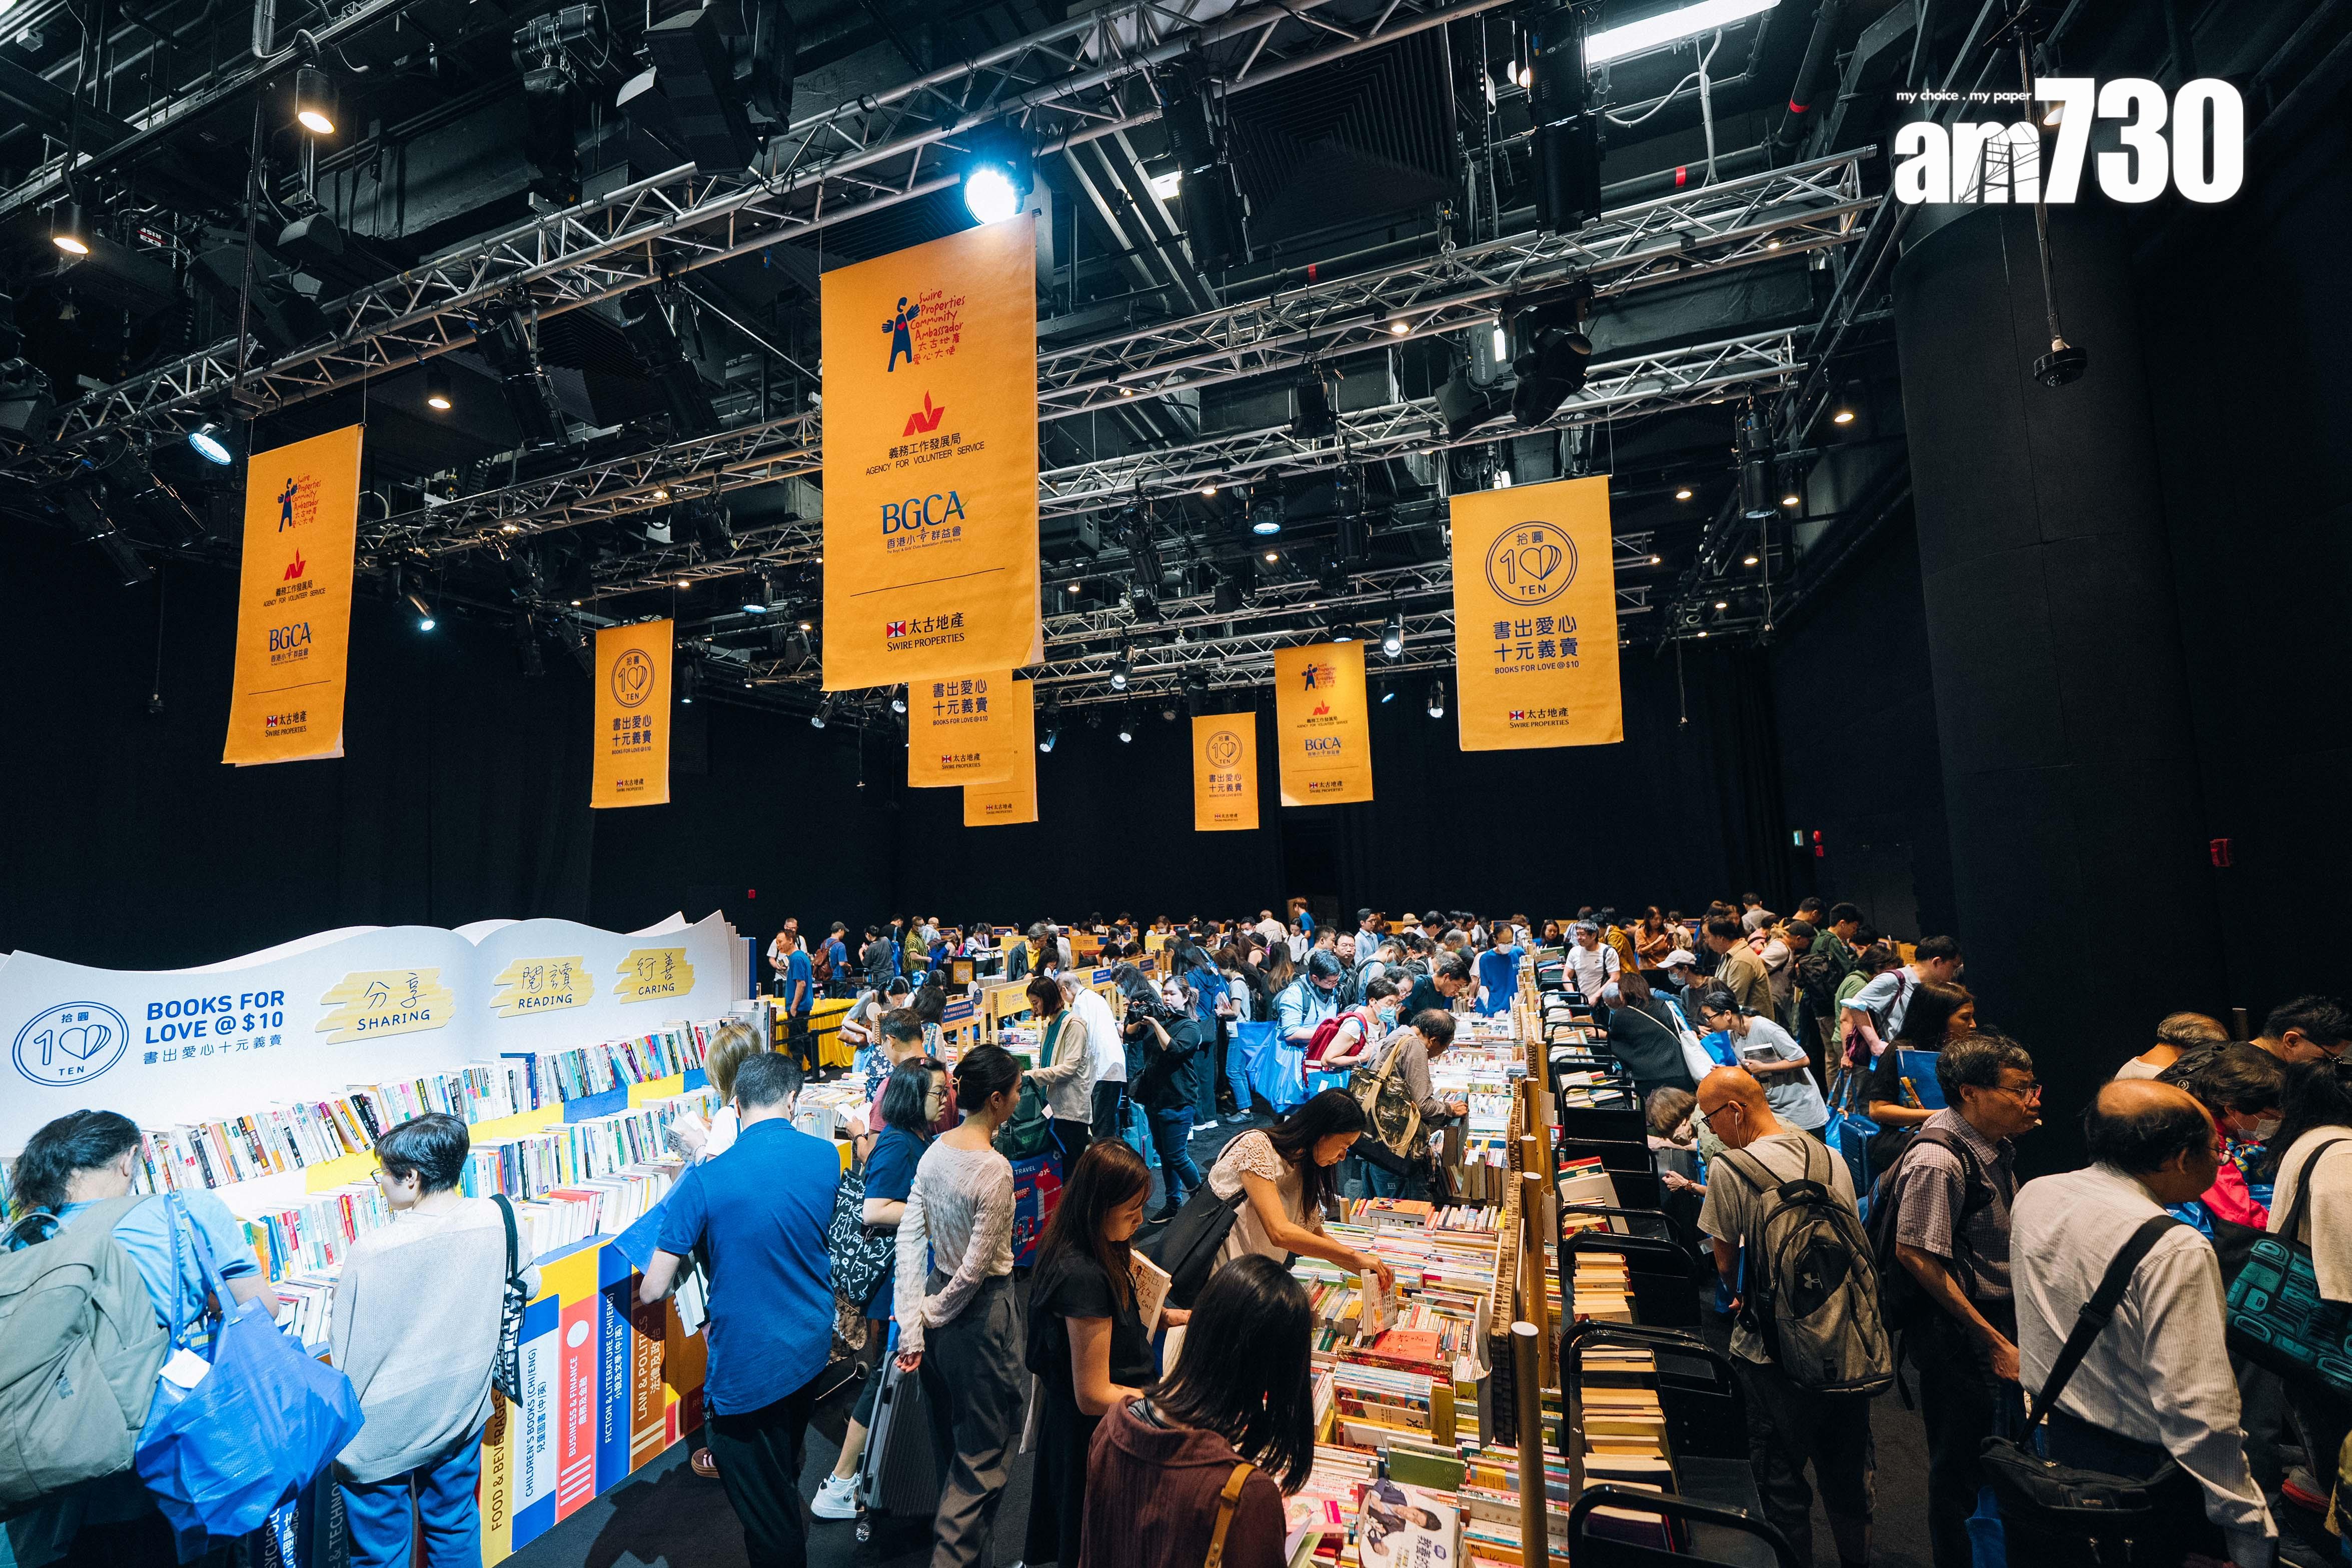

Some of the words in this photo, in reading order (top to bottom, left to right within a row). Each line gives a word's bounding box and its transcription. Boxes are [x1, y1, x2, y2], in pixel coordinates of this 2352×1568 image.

[919, 289, 942, 304] Swire
[921, 296, 965, 315] Properties
[911, 310, 957, 330] Community
[915, 322, 963, 341] Ambassador
[918, 333, 959, 351] 太古地產
[913, 346, 955, 365] 愛心大使
[889, 433, 960, 460] 義務工作發展局
[866, 463, 890, 476] AGENCY
[896, 459, 909, 469] FOR
[914, 449, 952, 465] VOLUNTEER
[957, 441, 984, 456] SERVICE
[297, 480, 321, 492] Properties
[298, 474, 310, 482] Swire
[292, 490, 317, 502] Community
[294, 500, 319, 511] Ambassador
[880, 491, 967, 535] BGCA
[887, 526, 961, 549] 香港小童群益會
[1517, 531, 1543, 546] 拾圓
[264, 598, 277, 607] AGENCY
[288, 592, 308, 601] VOLUNTEER
[310, 587, 326, 598] SERVICE
[276, 579, 313, 597] 義務工作發展局
[1519, 584, 1546, 595] TEN
[909, 612, 964, 635] 太古地產
[1493, 615, 1577, 639] 書出愛心
[269, 622, 312, 652] BGCA
[887, 640, 913, 652] SWIRE
[914, 633, 964, 648] PROPERTIES
[1494, 637, 1578, 663] 十元義賣
[1495, 665, 1519, 674] BOOKS
[1521, 664, 1536, 672] FOR
[1537, 662, 1556, 671] LOVE
[932, 679, 987, 698] 書出愛心
[933, 697, 987, 716] 十元義賣
[1526, 707, 1569, 719] 太古地產
[279, 711, 307, 725] 太古地產
[612, 714, 651, 731] 書出愛心
[1510, 720, 1530, 728] SWIRE
[1531, 718, 1569, 727] PROPERTIES
[281, 725, 307, 735] PROPERTIES
[612, 730, 651, 747] 十元義賣
[1305, 737, 1341, 750] BGCA
[953, 753, 980, 762] 太古地產
[624, 778, 644, 786] 太古地產
[1209, 773, 1242, 782] 書出愛心
[1209, 783, 1242, 793] 十元義賣
[637, 952, 676, 981] 行善
[364, 972, 427, 1009] 分享
[638, 983, 675, 995] CARING
[147, 995, 232, 1020] BOOKS
[240, 990, 284, 1010] FOR
[518, 994, 572, 1009] READING
[61, 1012, 89, 1023] 拾圓
[146, 1021, 208, 1044] LOVE
[215, 1016, 237, 1035] @
[242, 1010, 284, 1032] $10
[357, 1009, 430, 1030] SHARING
[143, 1033, 283, 1065] 書出愛心十元義賣
[59, 1065, 85, 1076] TEN
[1015, 1166, 1035, 1174] TRAVEL
[607, 1292, 615, 1340] (CHI/ENG)
[639, 1315, 648, 1377] POLITICS
[650, 1327, 661, 1394] 法律及政治
[527, 1348, 538, 1396] (CHI/ENG)
[570, 1355, 578, 1398] FINANCE
[639, 1377, 647, 1390] &
[569, 1399, 577, 1410] &
[578, 1375, 588, 1425] 商務及金融
[606, 1392, 614, 1404] &
[639, 1391, 647, 1421] LAW
[527, 1396, 536, 1433] BOOKS
[493, 1394, 507, 1469] BEVERAGES
[568, 1411, 577, 1457] BUSINESS
[526, 1434, 535, 1497] CHILDREN'S
[493, 1473, 503, 1486] &
[491, 1489, 503, 1531] FOOD
